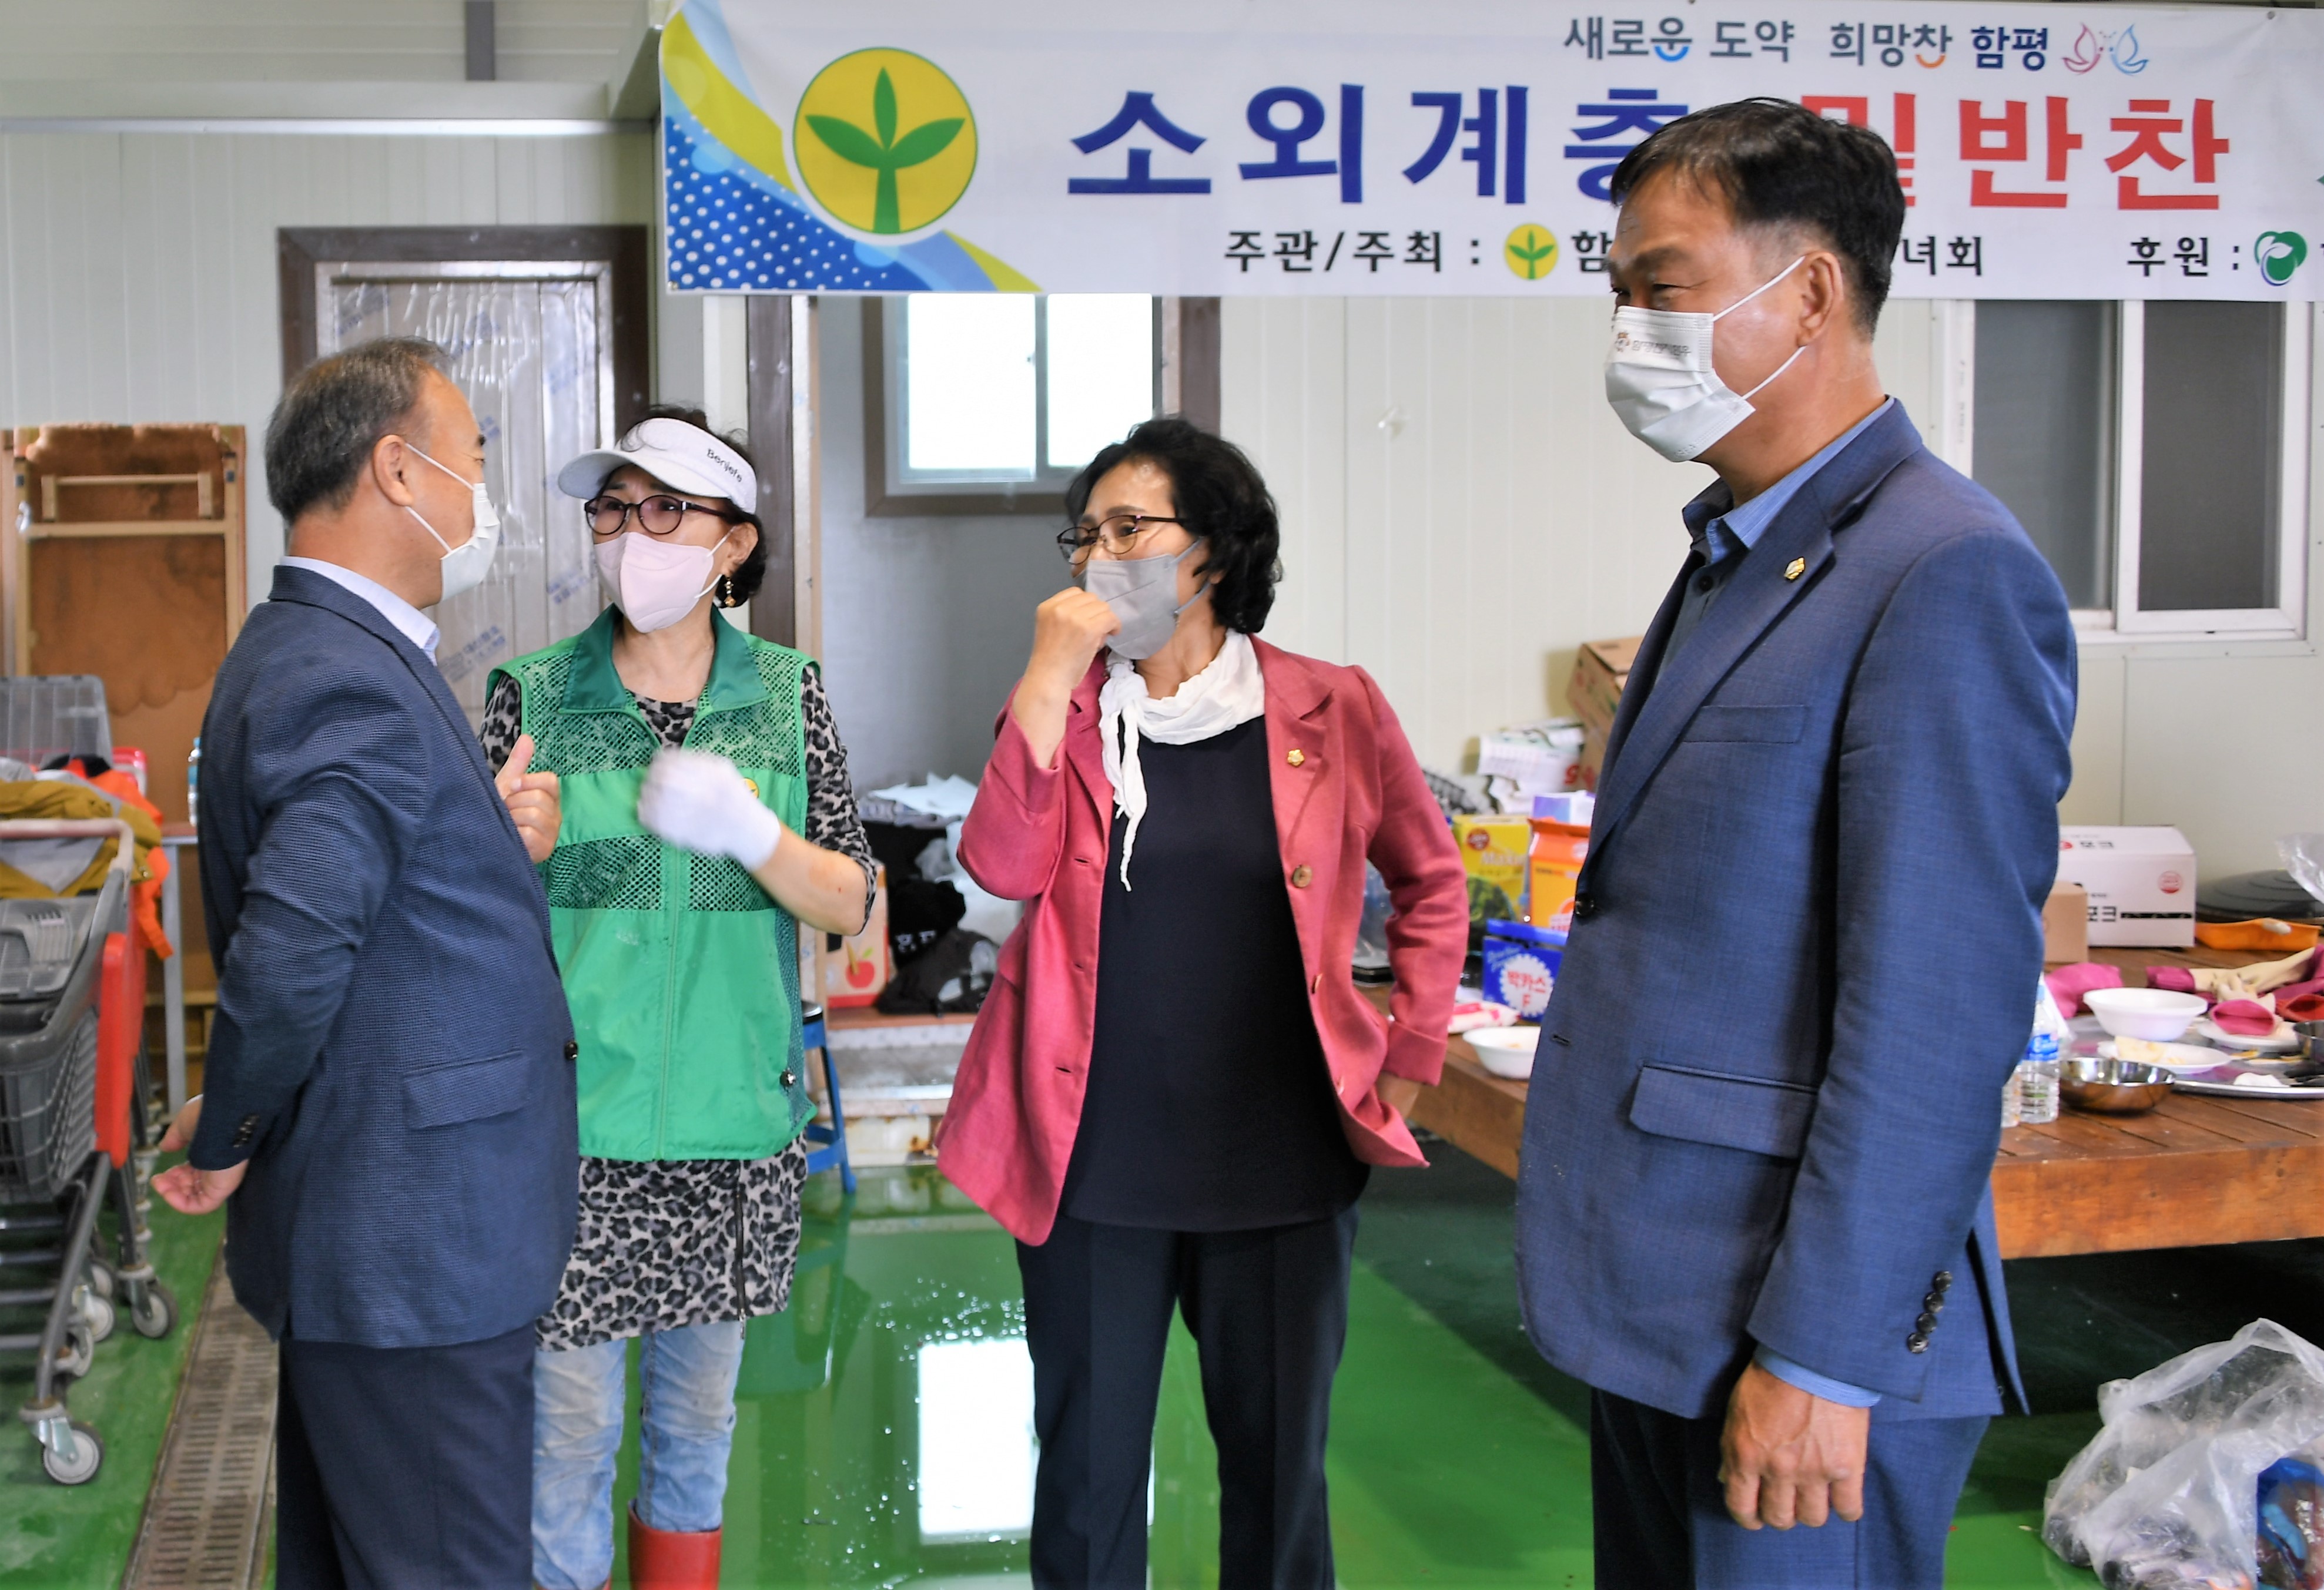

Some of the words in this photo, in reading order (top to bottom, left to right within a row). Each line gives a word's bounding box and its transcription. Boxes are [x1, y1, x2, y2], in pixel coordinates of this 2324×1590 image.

[1564, 16, 1693, 62] 새로운
[1709, 20, 1796, 62] 도약
[1830, 22, 1953, 69] 희망찬
[1971, 26, 2048, 72] 함평
[1067, 83, 1689, 205] 소외계층
[1224, 230, 1442, 273] 주관/주최
[2127, 236, 2209, 277] 후원
